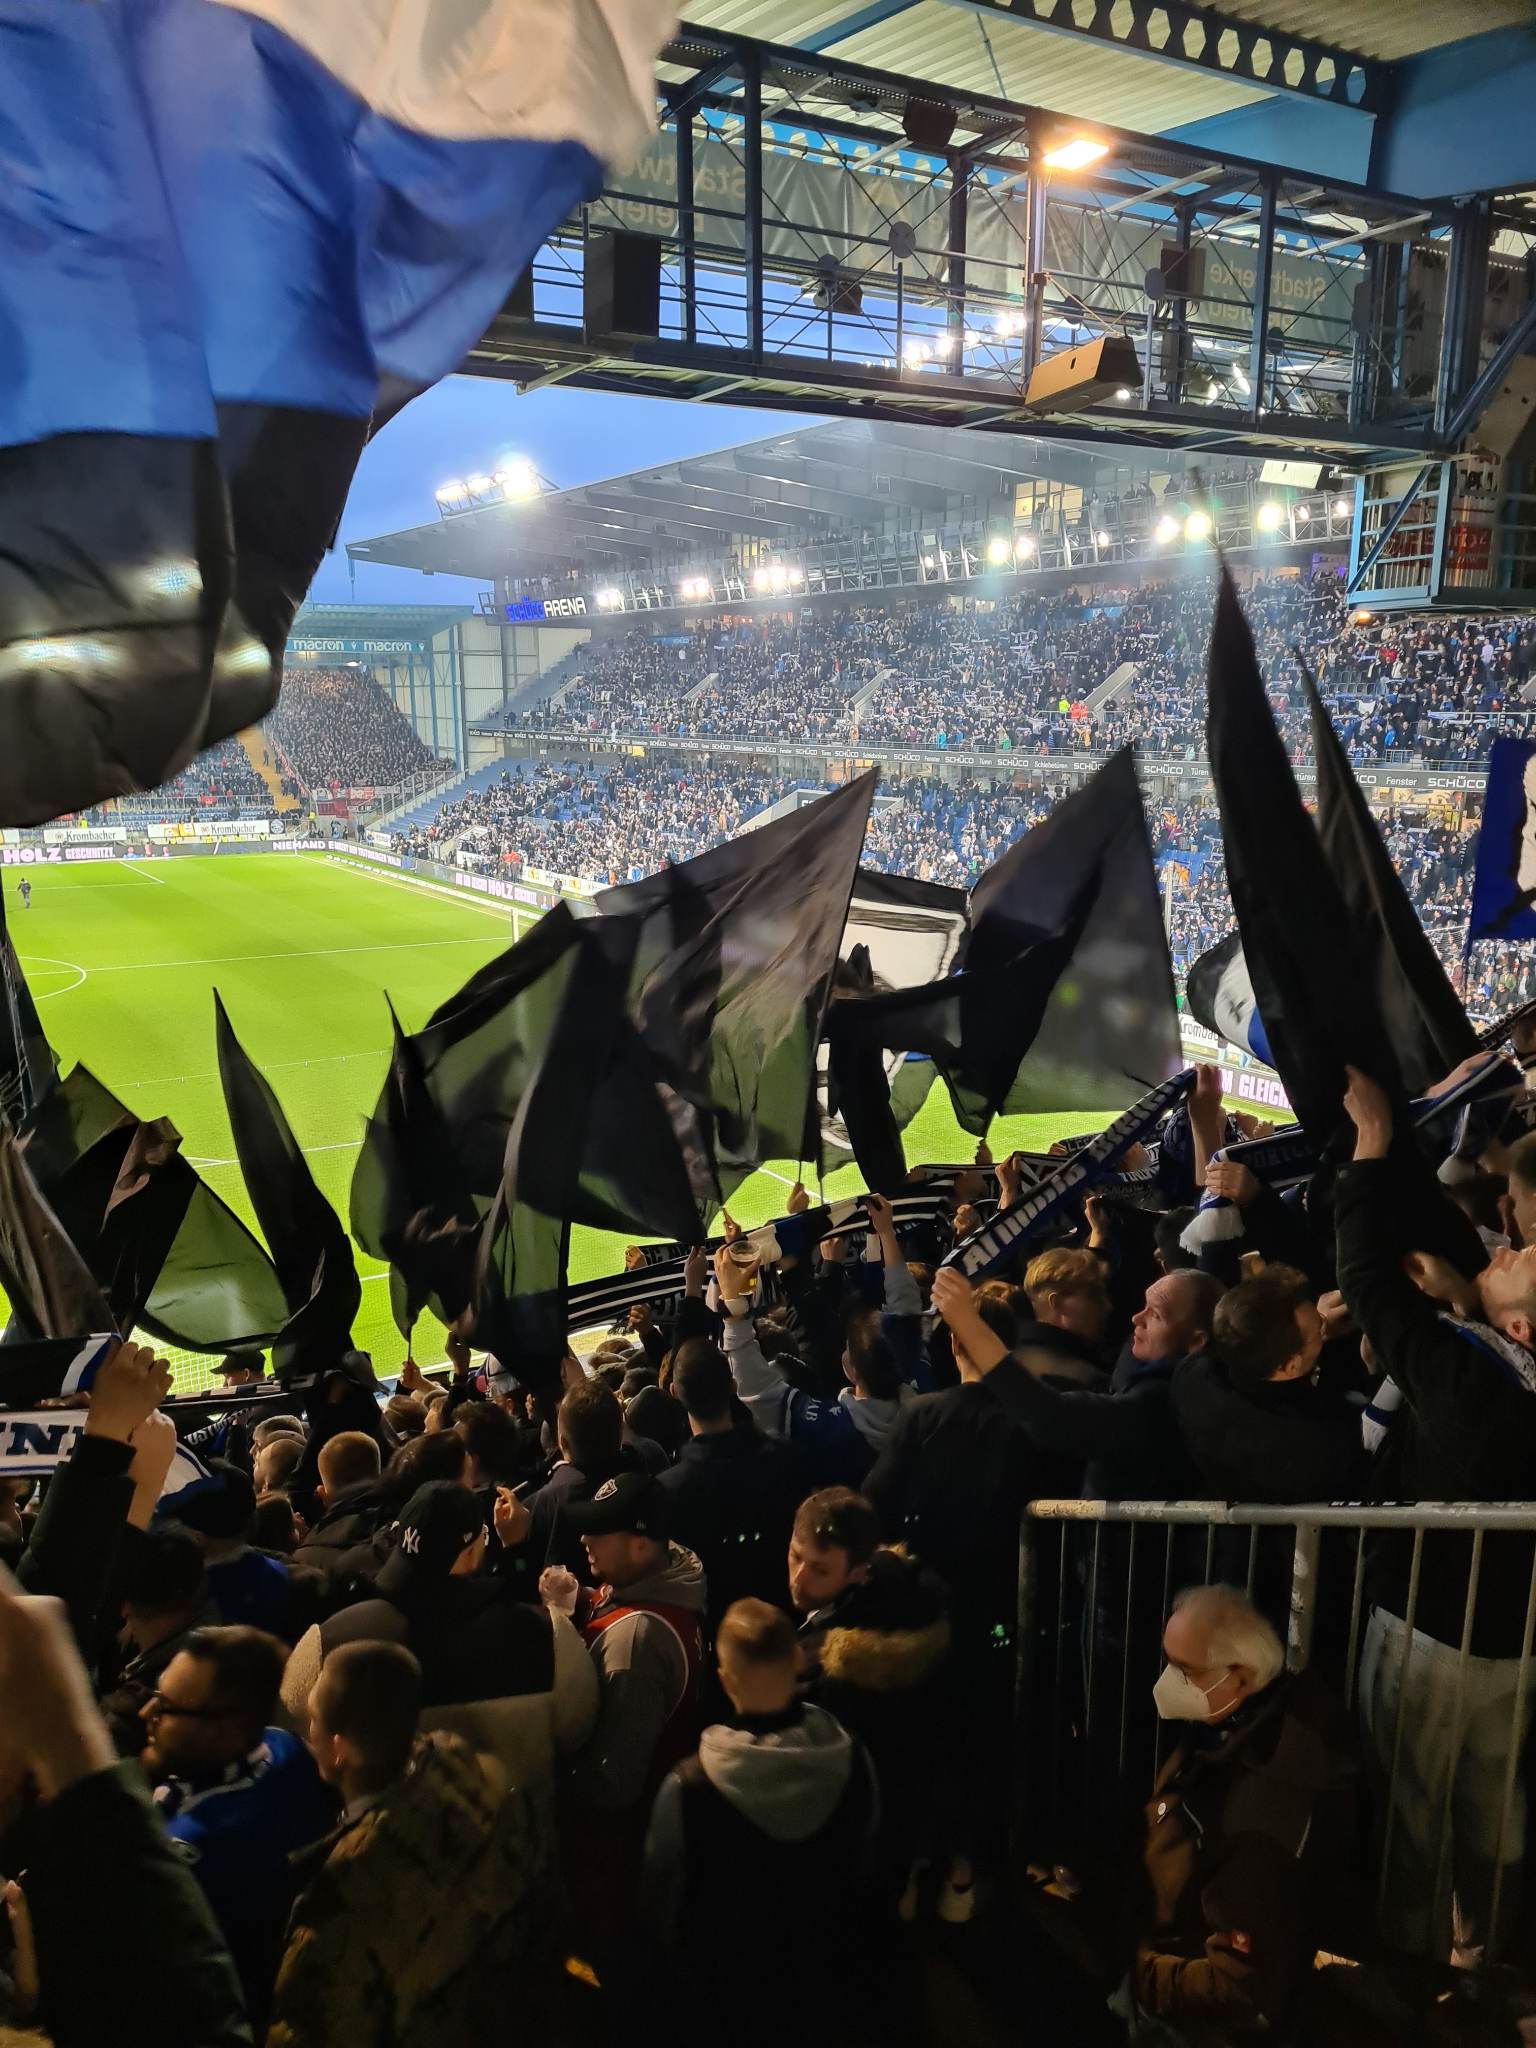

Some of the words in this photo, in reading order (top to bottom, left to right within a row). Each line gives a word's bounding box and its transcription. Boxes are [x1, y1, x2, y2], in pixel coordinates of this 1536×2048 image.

[543, 597, 586, 618] ARENA
[293, 640, 344, 651] macron
[364, 640, 411, 652] macron
[834, 750, 859, 758] SCHÜCO
[893, 752, 920, 761] SCHÜCO
[945, 754, 975, 764] SCHÜCO
[997, 757, 1029, 768] SCHÜCO
[1143, 763, 1183, 775] SCHÜCO
[1191, 767, 1209, 776] Türen
[1386, 776, 1417, 786] Fenster
[1427, 774, 1487, 789] SCHÜCO
[211, 823, 256, 835] Krombacher
[66, 830, 117, 841] Krombacher
[273, 841, 326, 851] NIEMAND
[3, 848, 62, 864] HOLZ
[402, 1525, 420, 1554] NY
